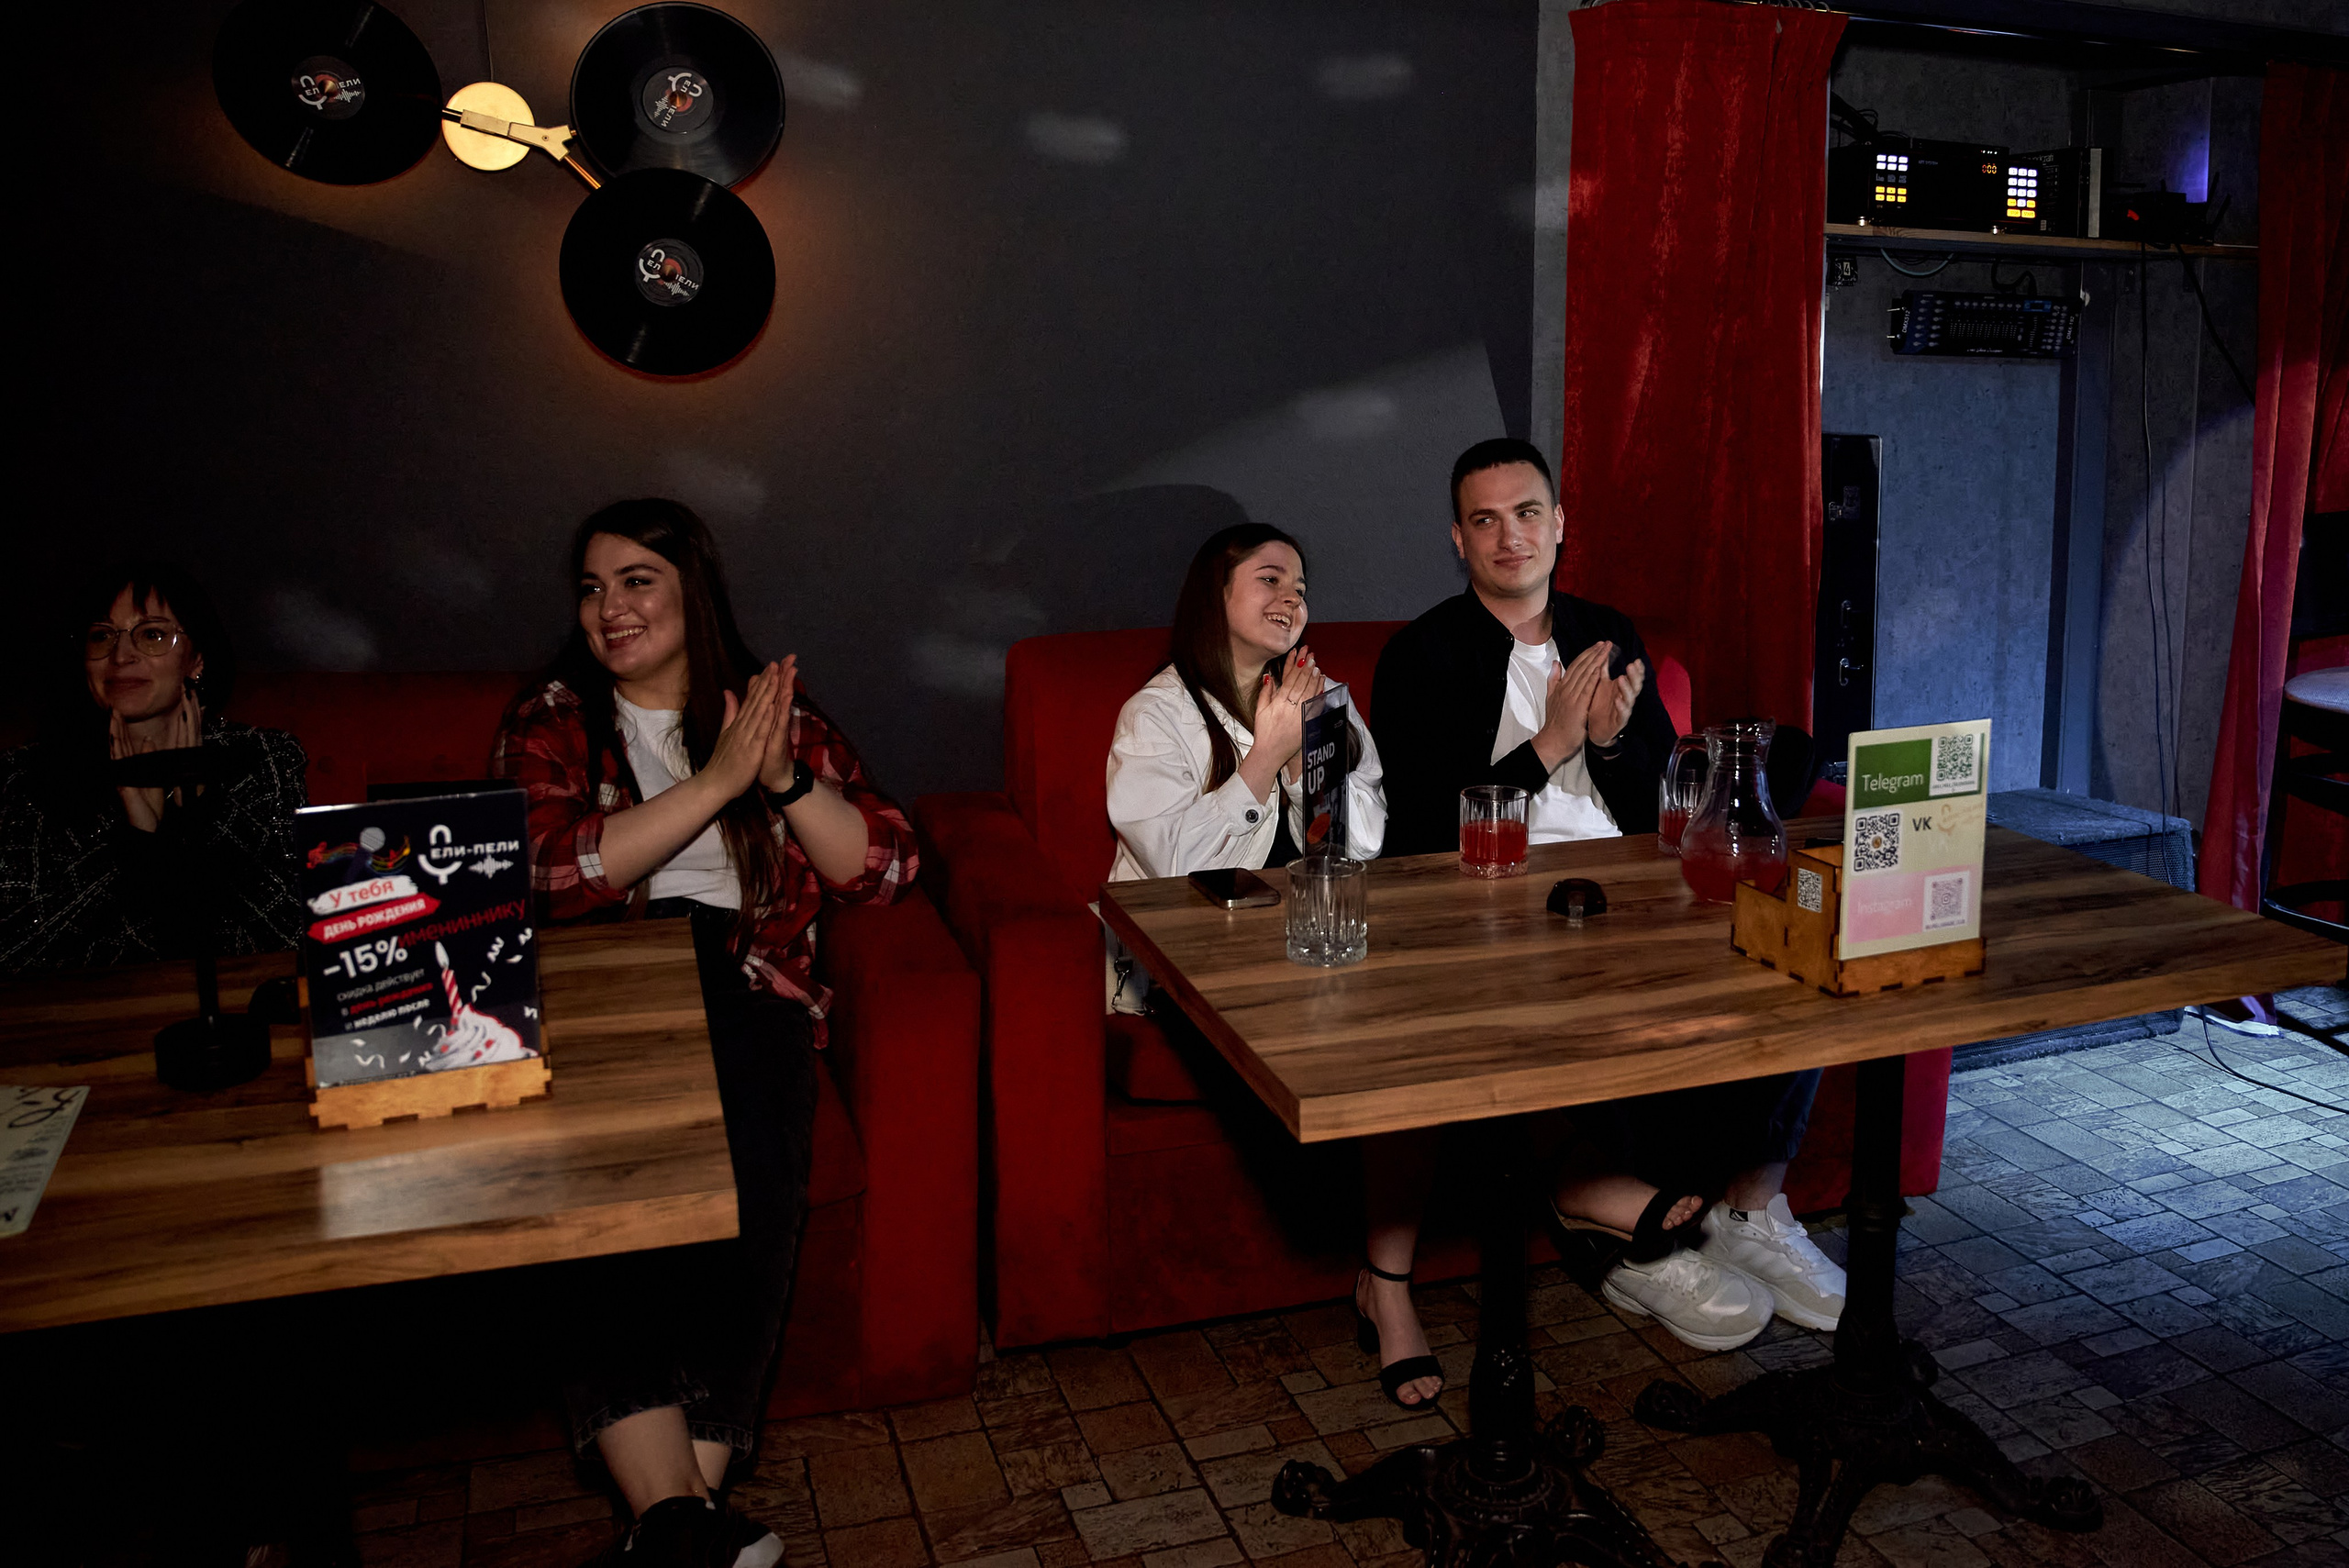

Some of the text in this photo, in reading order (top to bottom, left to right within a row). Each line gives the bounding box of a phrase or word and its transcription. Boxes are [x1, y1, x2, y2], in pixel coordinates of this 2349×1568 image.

[1307, 741, 1335, 769] STAND
[1307, 765, 1326, 795] UP
[1861, 773, 1924, 794] Telegram
[1912, 816, 1932, 832] VK
[430, 840, 519, 860] ЕЛИ-ПЕЛИ
[329, 879, 395, 908] У тебя
[323, 898, 427, 940] ДЕНЬ РОЖДЕНИЯ
[323, 935, 409, 979] -15%
